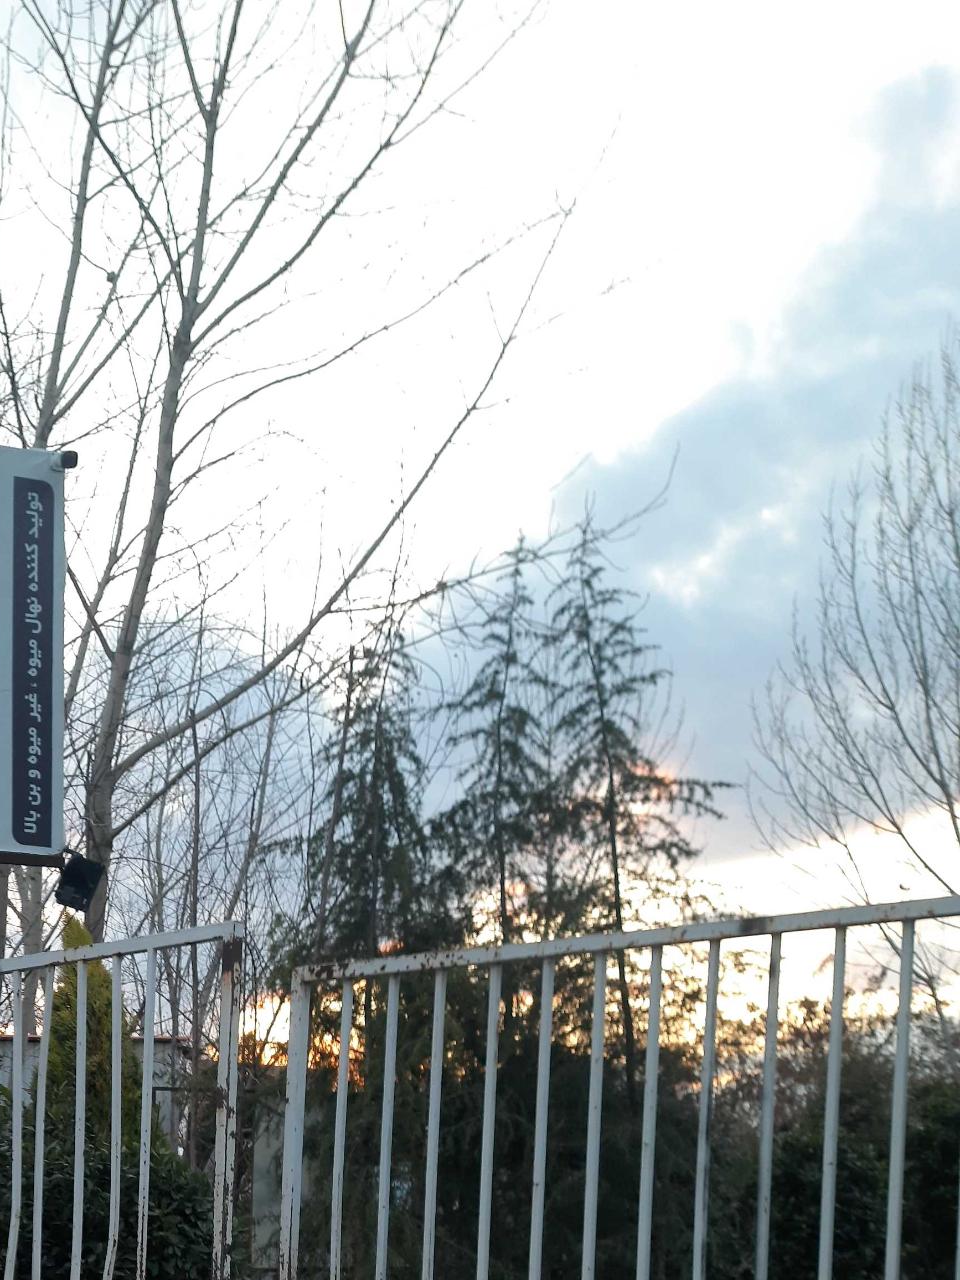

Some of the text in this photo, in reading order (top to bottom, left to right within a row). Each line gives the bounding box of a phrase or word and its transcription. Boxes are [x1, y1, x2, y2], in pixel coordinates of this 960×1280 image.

[26, 492, 43, 538] تولید
[25, 543, 39, 592] کننده
[25, 596, 42, 634] نهال
[28, 639, 42, 677] میوه
[25, 692, 42, 723] غیر
[28, 726, 42, 765] میوه
[28, 769, 41, 779] و
[23, 810, 41, 834] بالا
